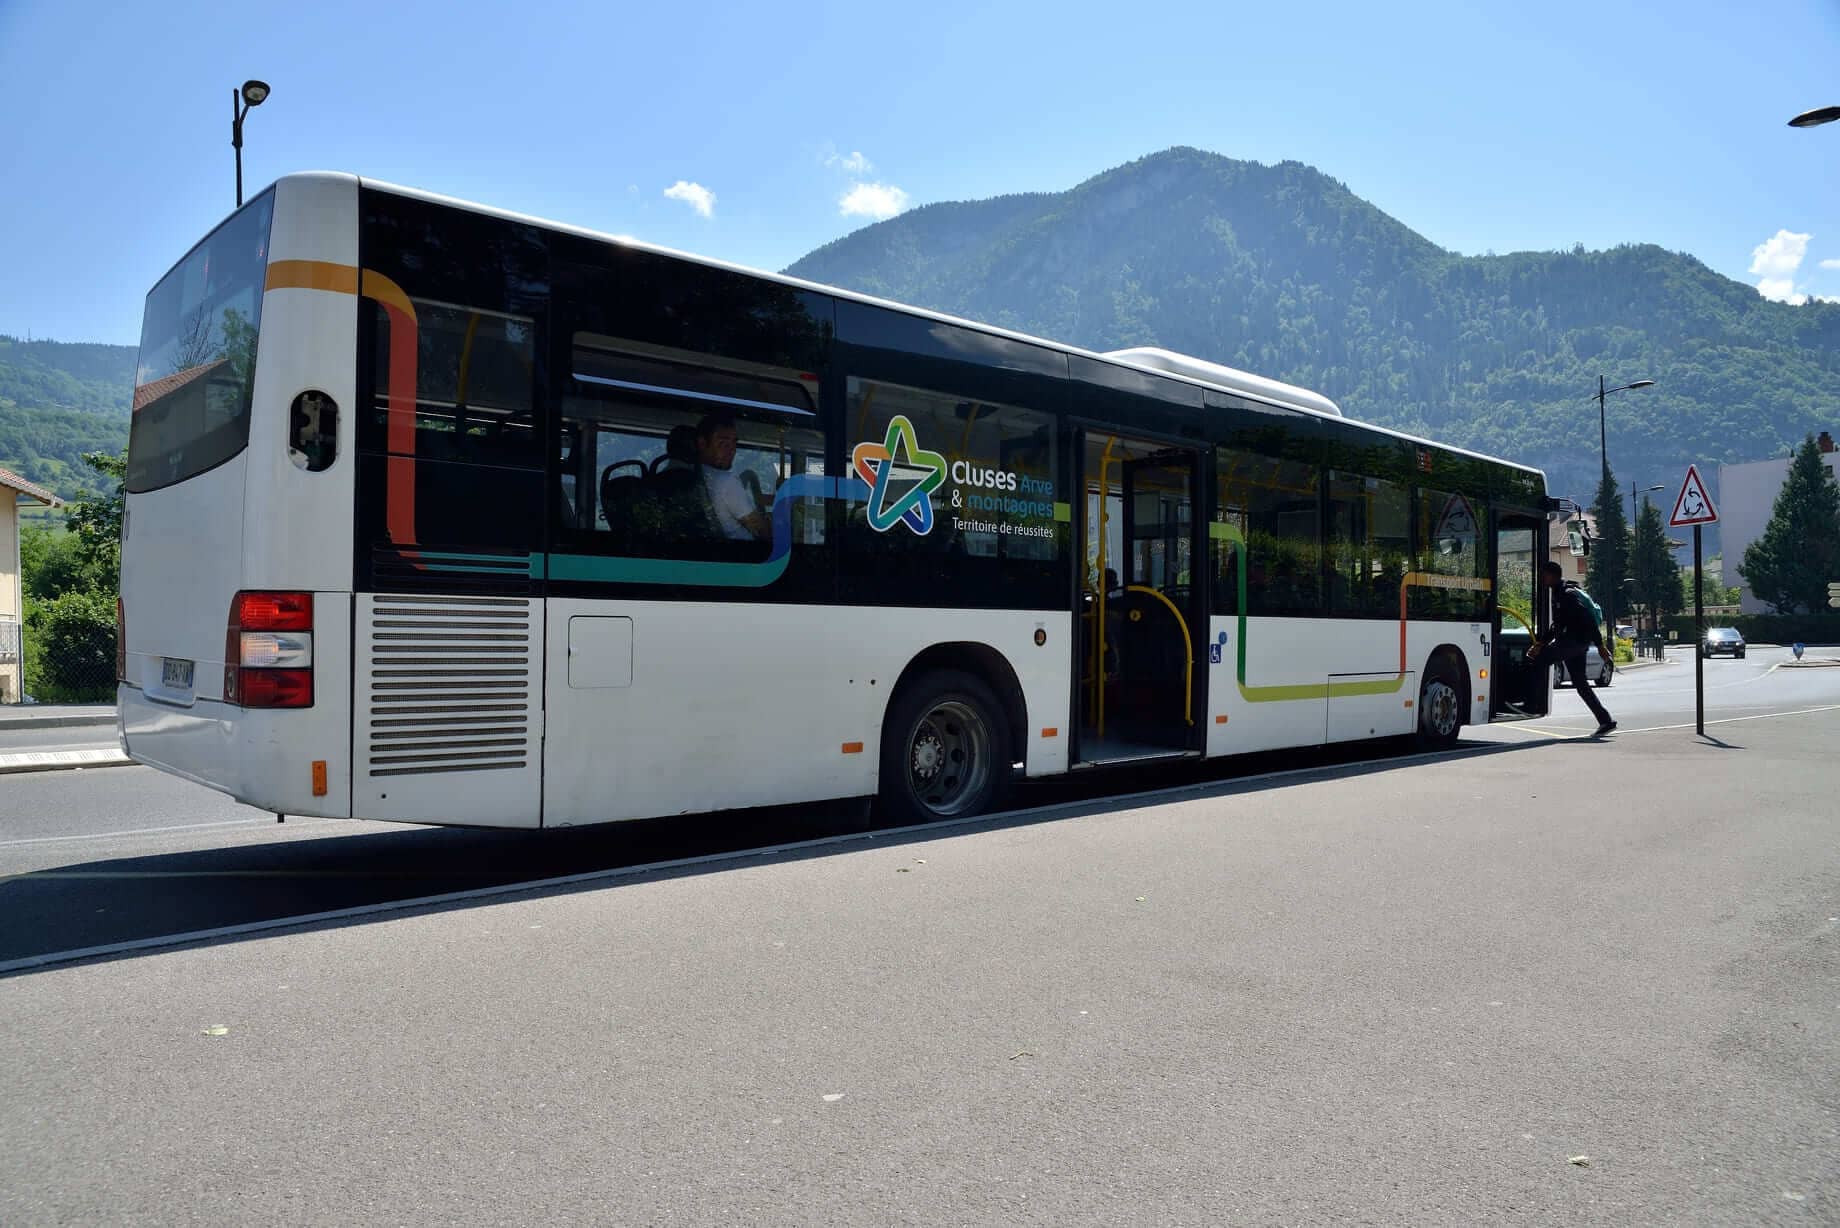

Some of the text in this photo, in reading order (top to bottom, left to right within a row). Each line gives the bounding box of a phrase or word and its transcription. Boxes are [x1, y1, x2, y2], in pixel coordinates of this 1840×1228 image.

[952, 460, 1053, 495] Cluses Arve
[951, 488, 1053, 518] & montagnes
[952, 516, 1054, 538] Territoire de réussites
